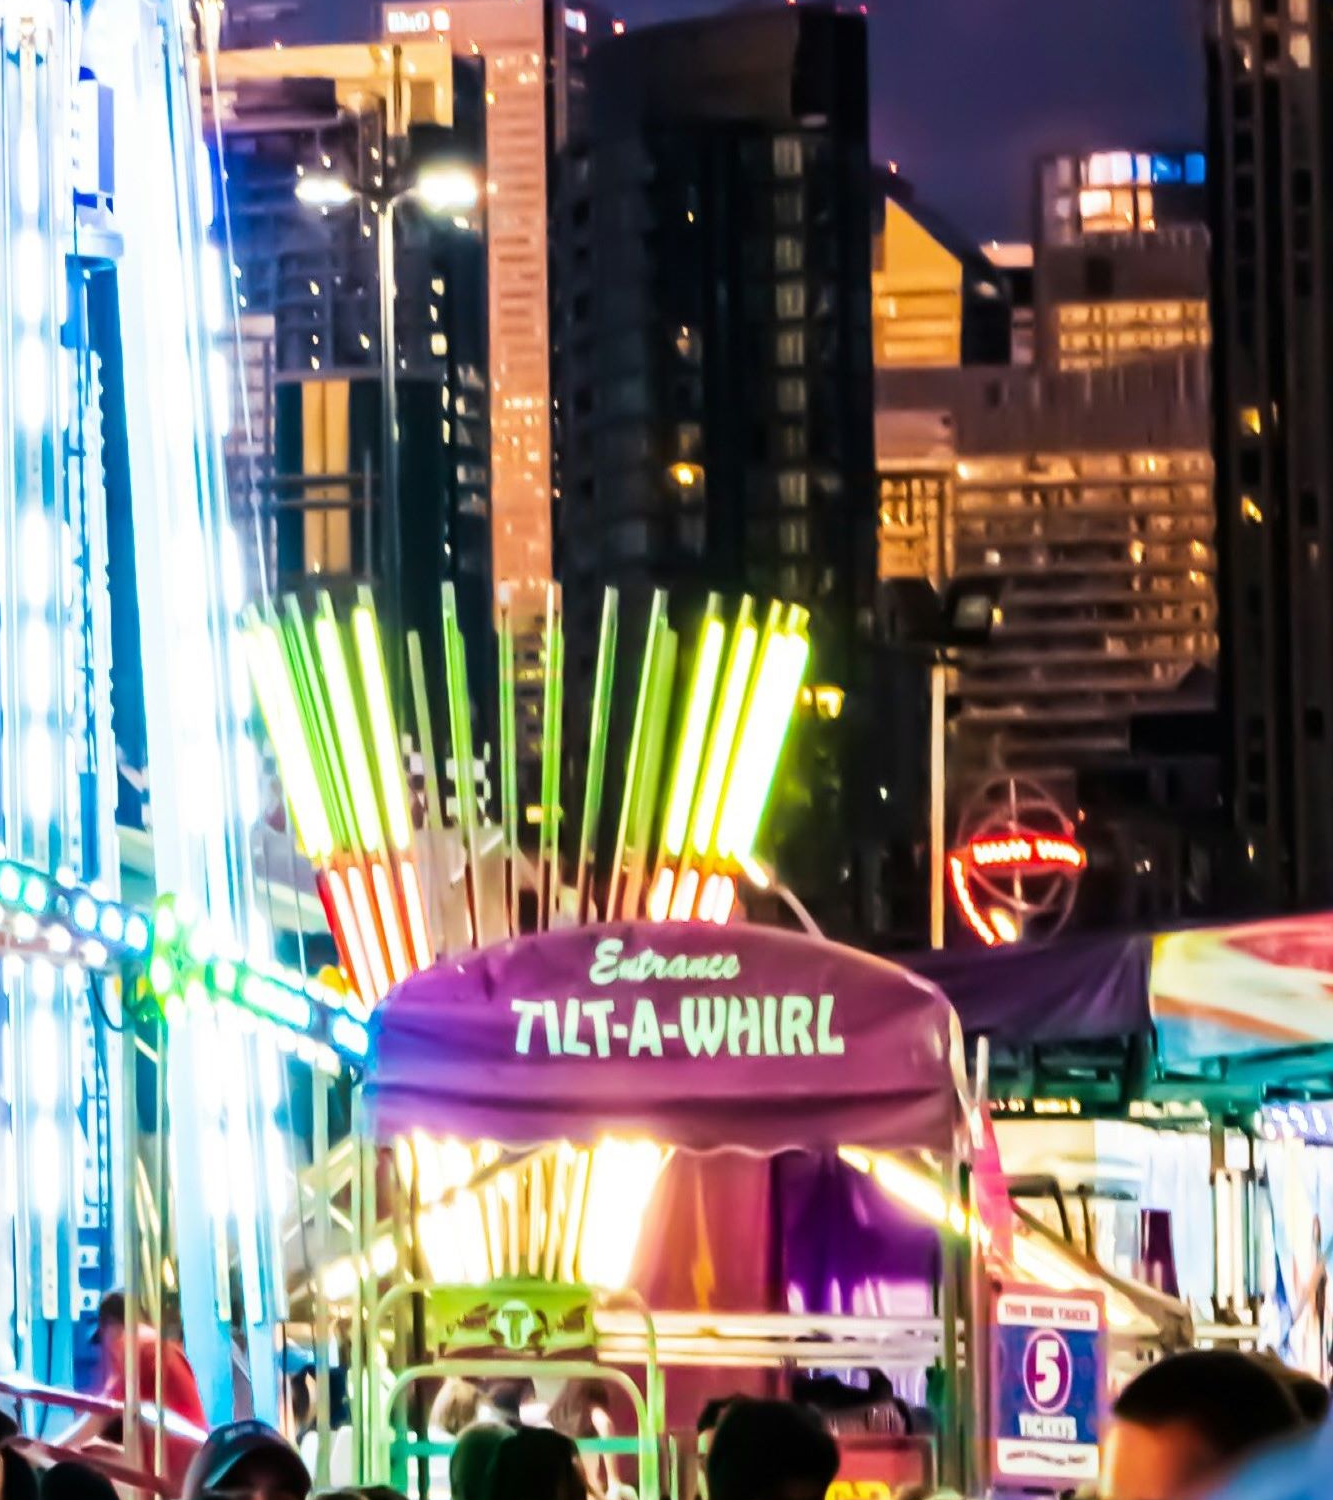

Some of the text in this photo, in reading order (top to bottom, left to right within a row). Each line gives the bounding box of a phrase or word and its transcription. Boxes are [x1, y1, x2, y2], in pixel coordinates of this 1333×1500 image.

[589, 938, 741, 985] Entrance
[511, 995, 845, 1057] TILT-A-WHIRL
[1034, 1339, 1061, 1403] 5
